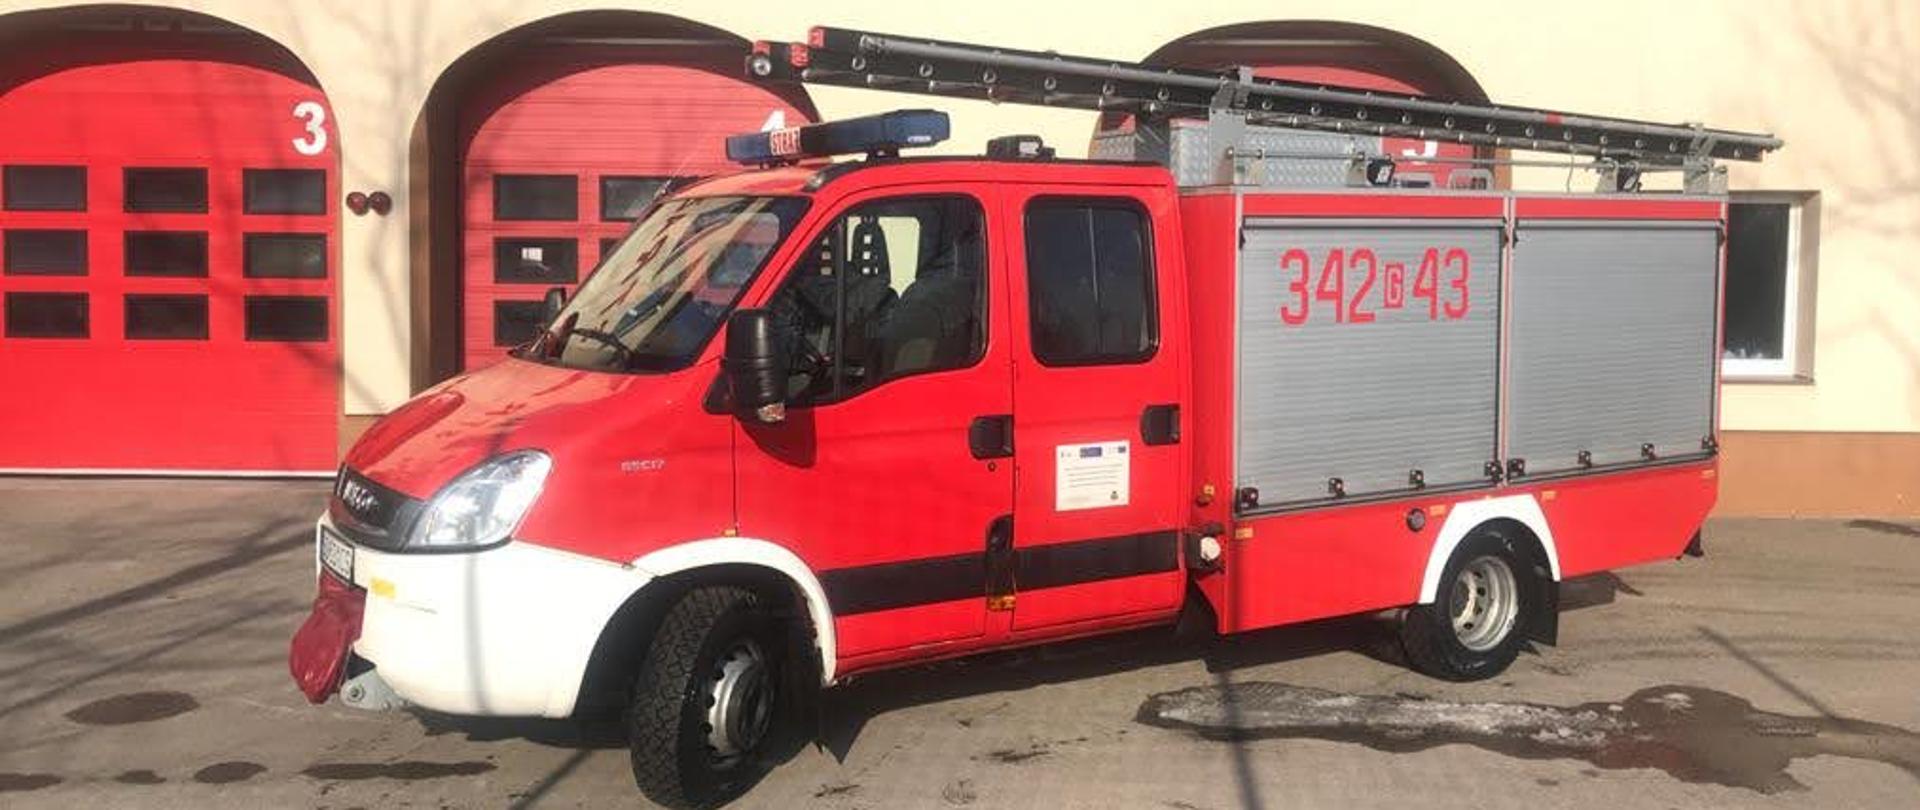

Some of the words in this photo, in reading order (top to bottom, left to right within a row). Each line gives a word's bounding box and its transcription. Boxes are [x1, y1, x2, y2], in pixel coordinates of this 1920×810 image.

[292, 101, 327, 156] 3
[1280, 247, 1377, 325] 342
[1412, 247, 1470, 320] 43
